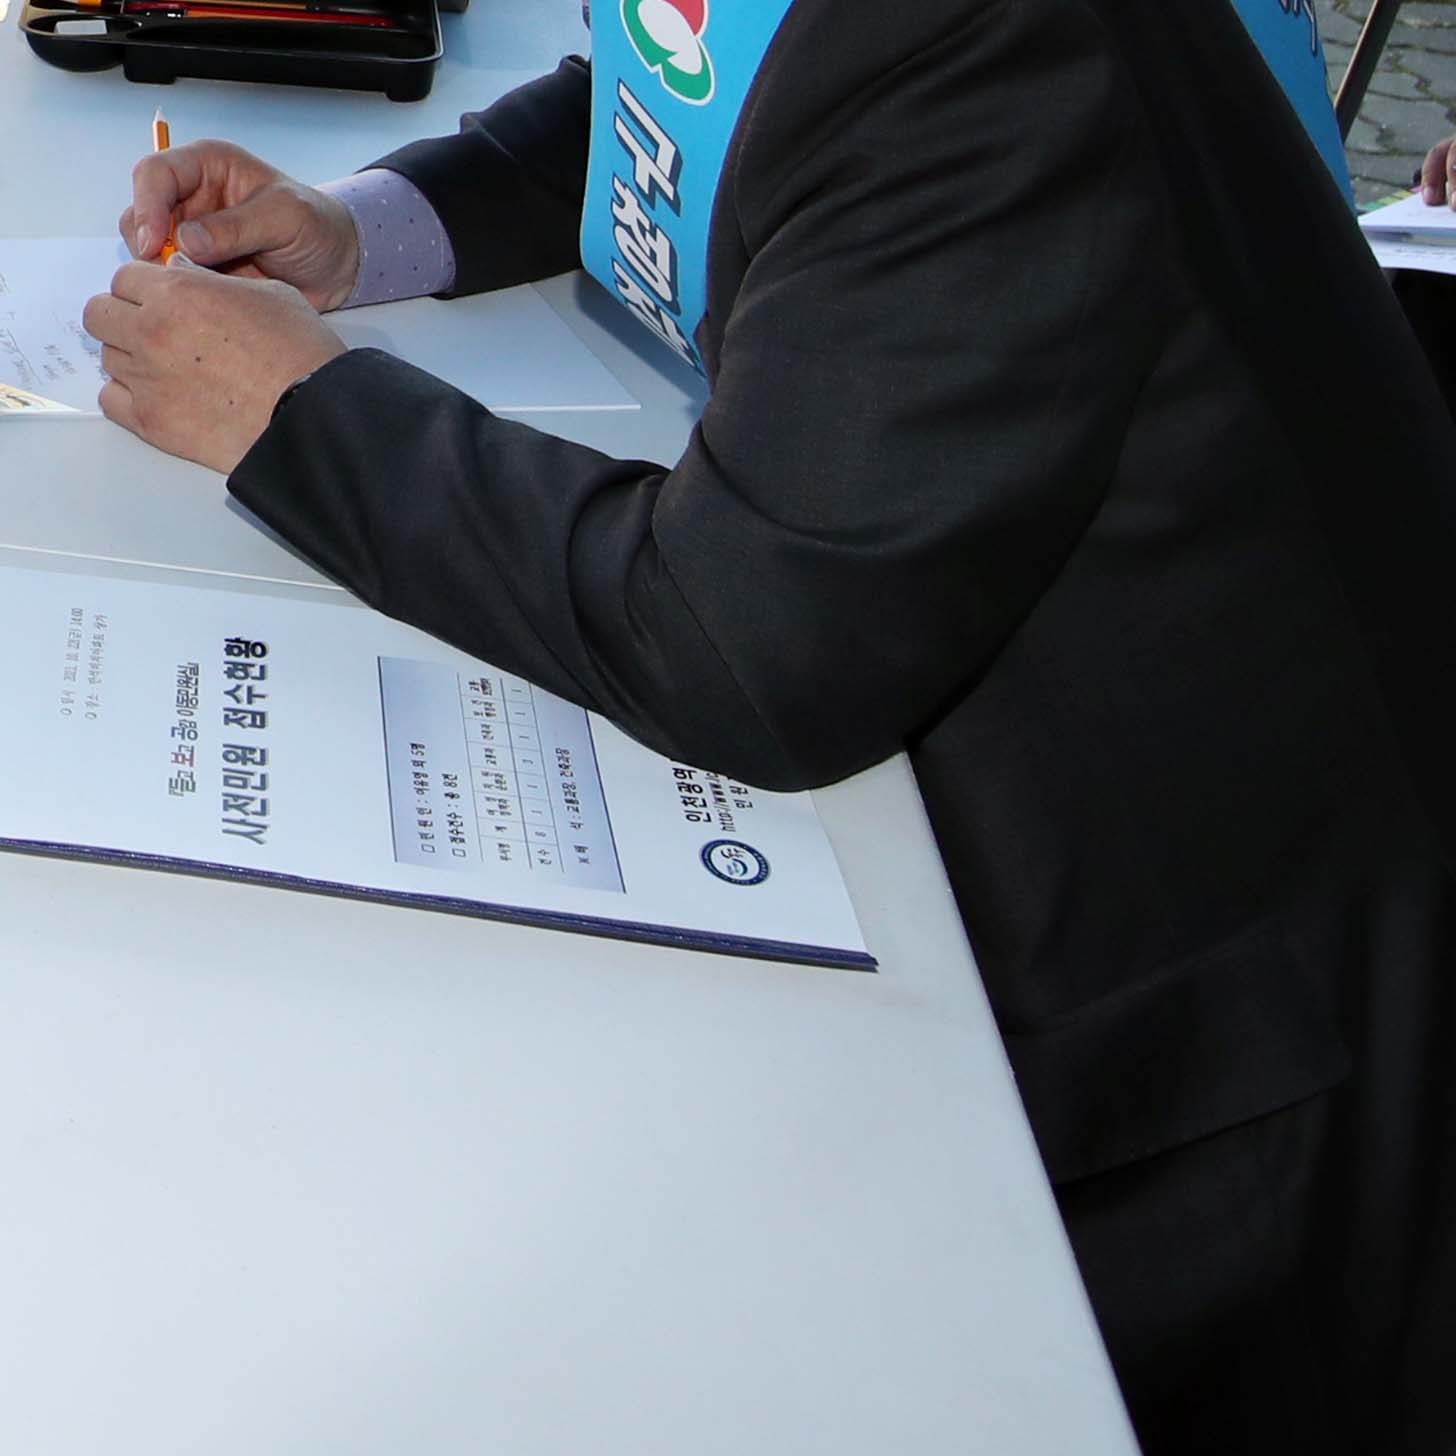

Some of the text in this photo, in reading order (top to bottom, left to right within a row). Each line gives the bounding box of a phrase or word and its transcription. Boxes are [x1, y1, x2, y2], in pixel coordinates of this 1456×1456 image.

[171, 744, 195, 767] 보고
[221, 637, 269, 845] 사전민원 접수현황
